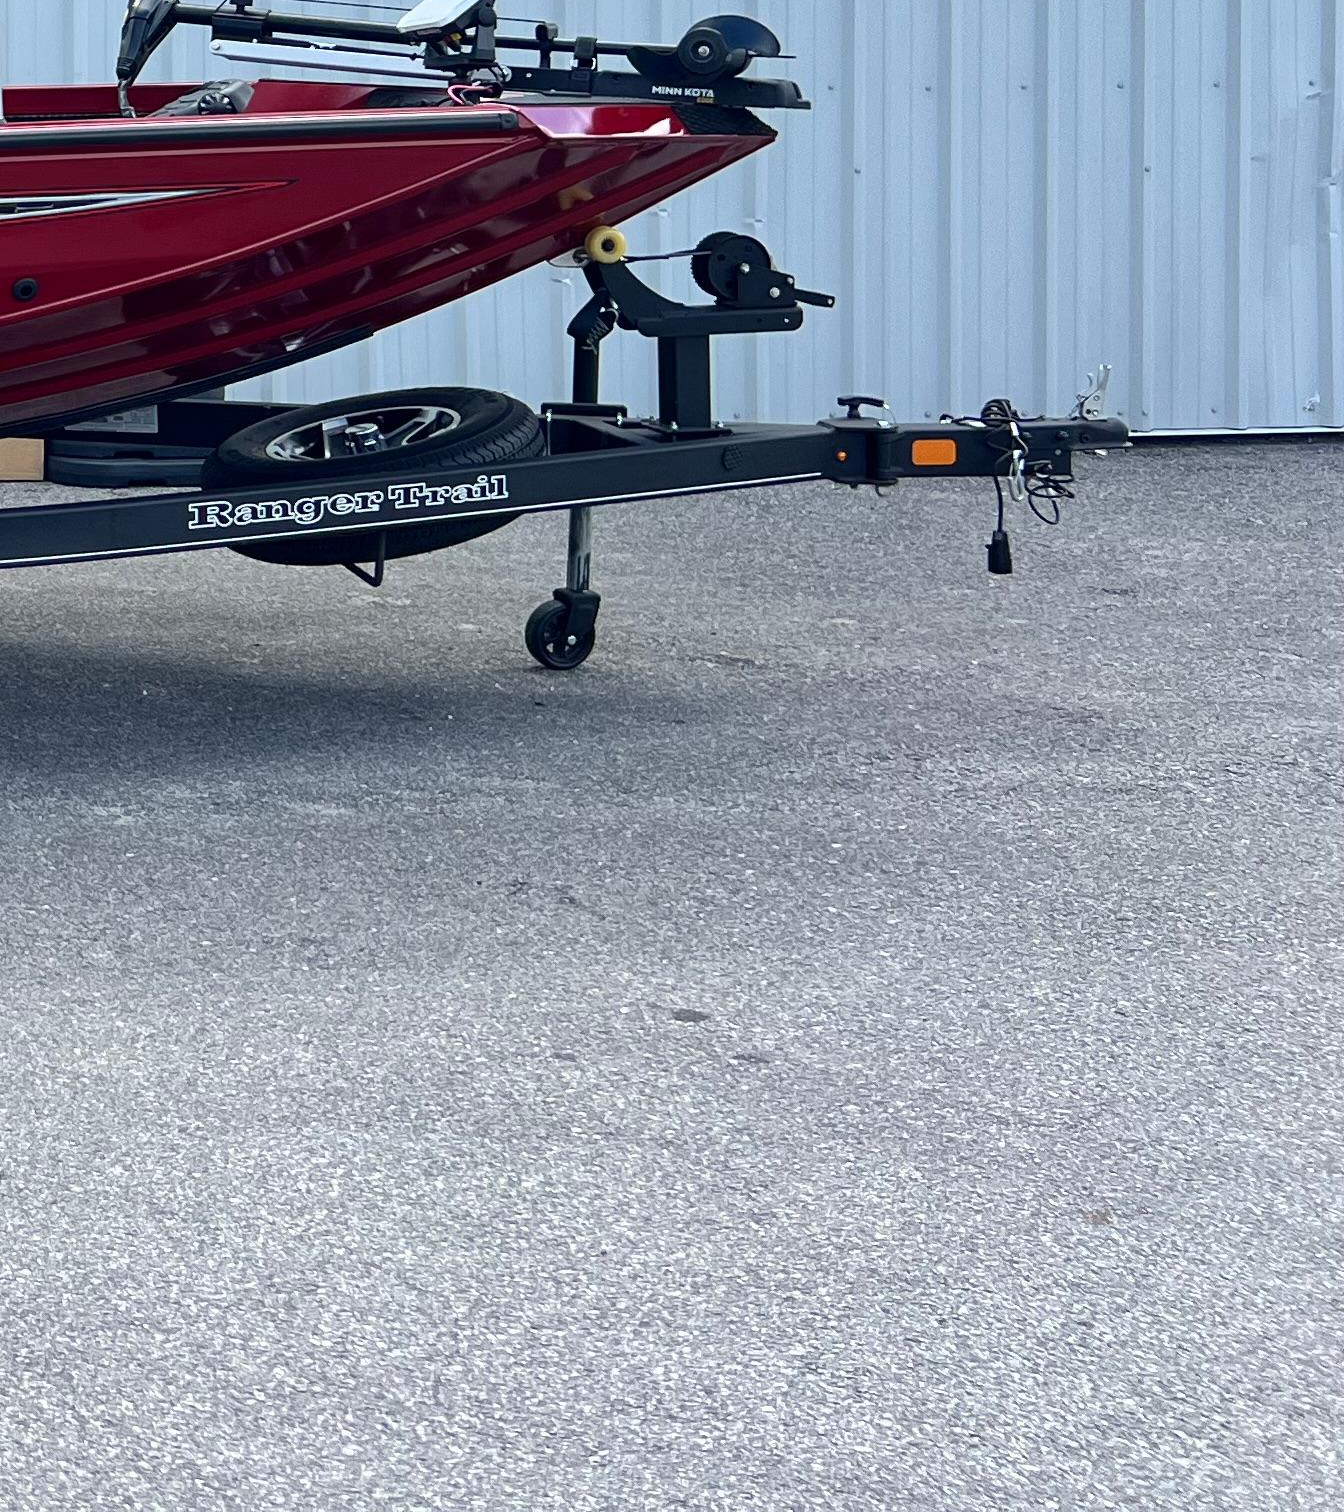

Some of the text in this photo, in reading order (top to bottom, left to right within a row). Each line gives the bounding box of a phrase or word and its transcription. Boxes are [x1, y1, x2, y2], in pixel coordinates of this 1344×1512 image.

[651, 85, 715, 98] MINN KOTA
[188, 475, 509, 529] Ranger Trail
